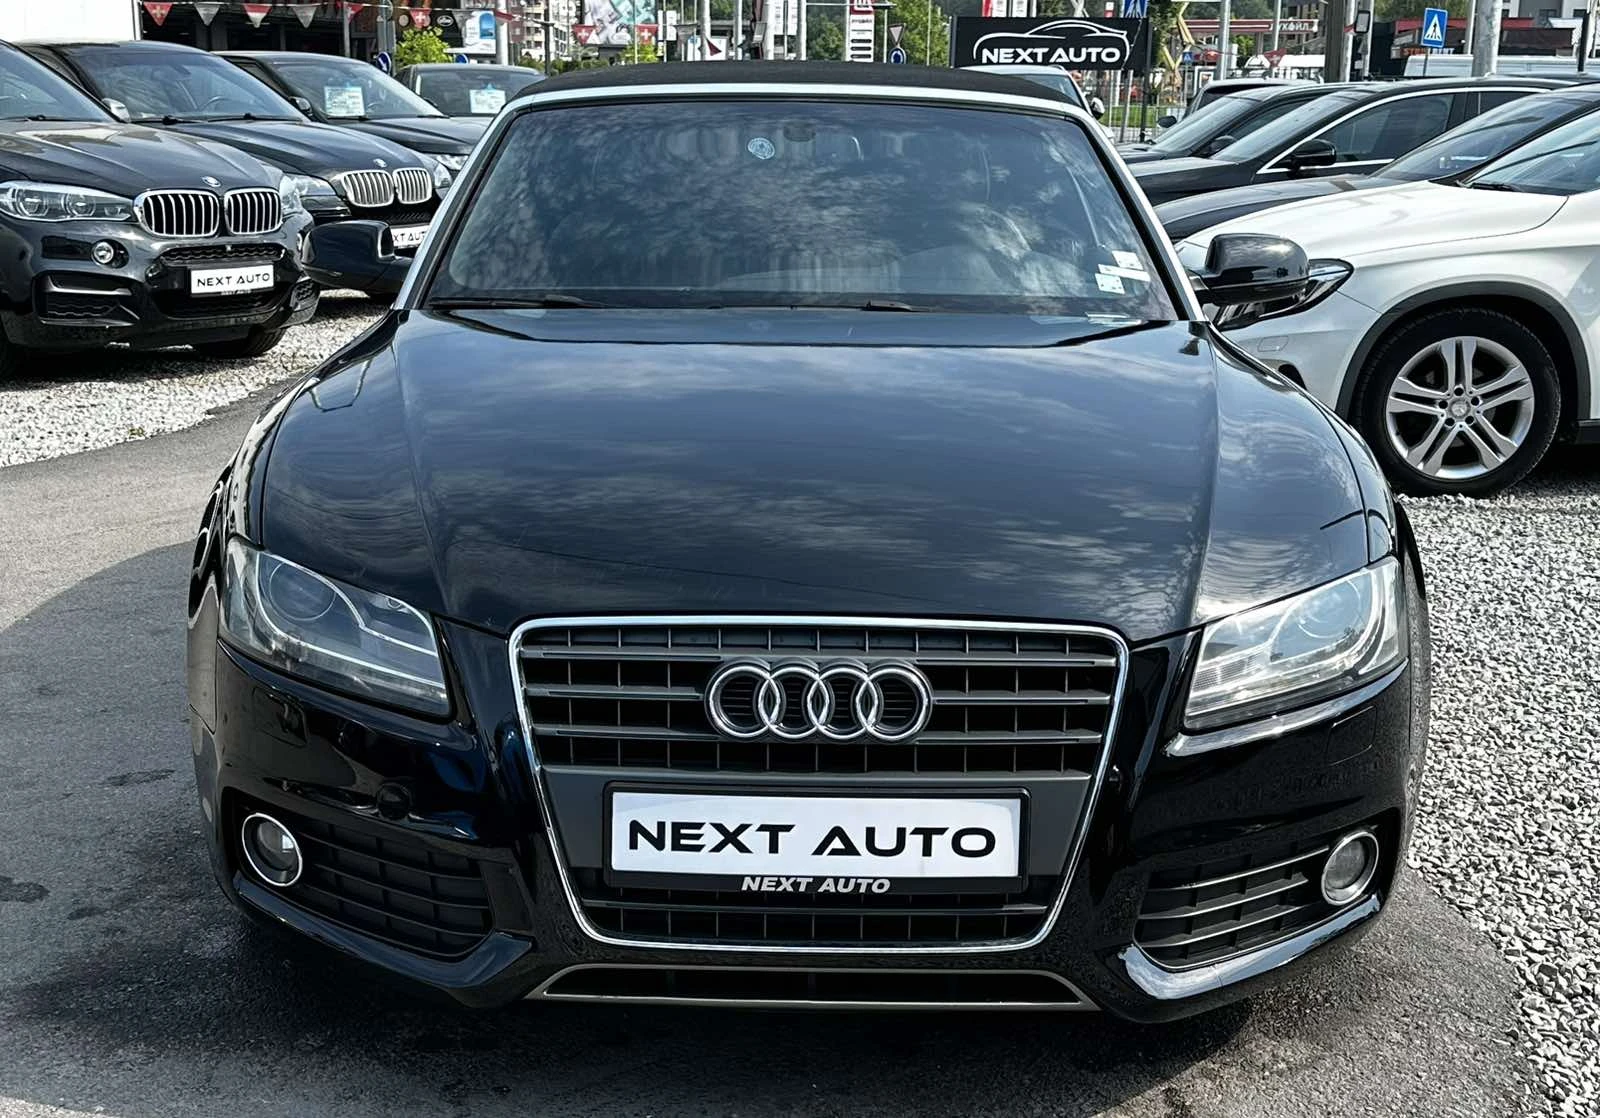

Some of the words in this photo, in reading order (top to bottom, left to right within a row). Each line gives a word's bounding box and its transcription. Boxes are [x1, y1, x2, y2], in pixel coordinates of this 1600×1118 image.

[982, 48, 1049, 63] NEXT
[1050, 48, 1121, 63] AUTO
[197, 276, 232, 287] NEXT
[237, 272, 270, 284] AUTO
[629, 819, 796, 854] NEXT
[811, 825, 997, 858] AUTO
[742, 876, 813, 892] NEXT
[818, 877, 891, 894] AUTO
